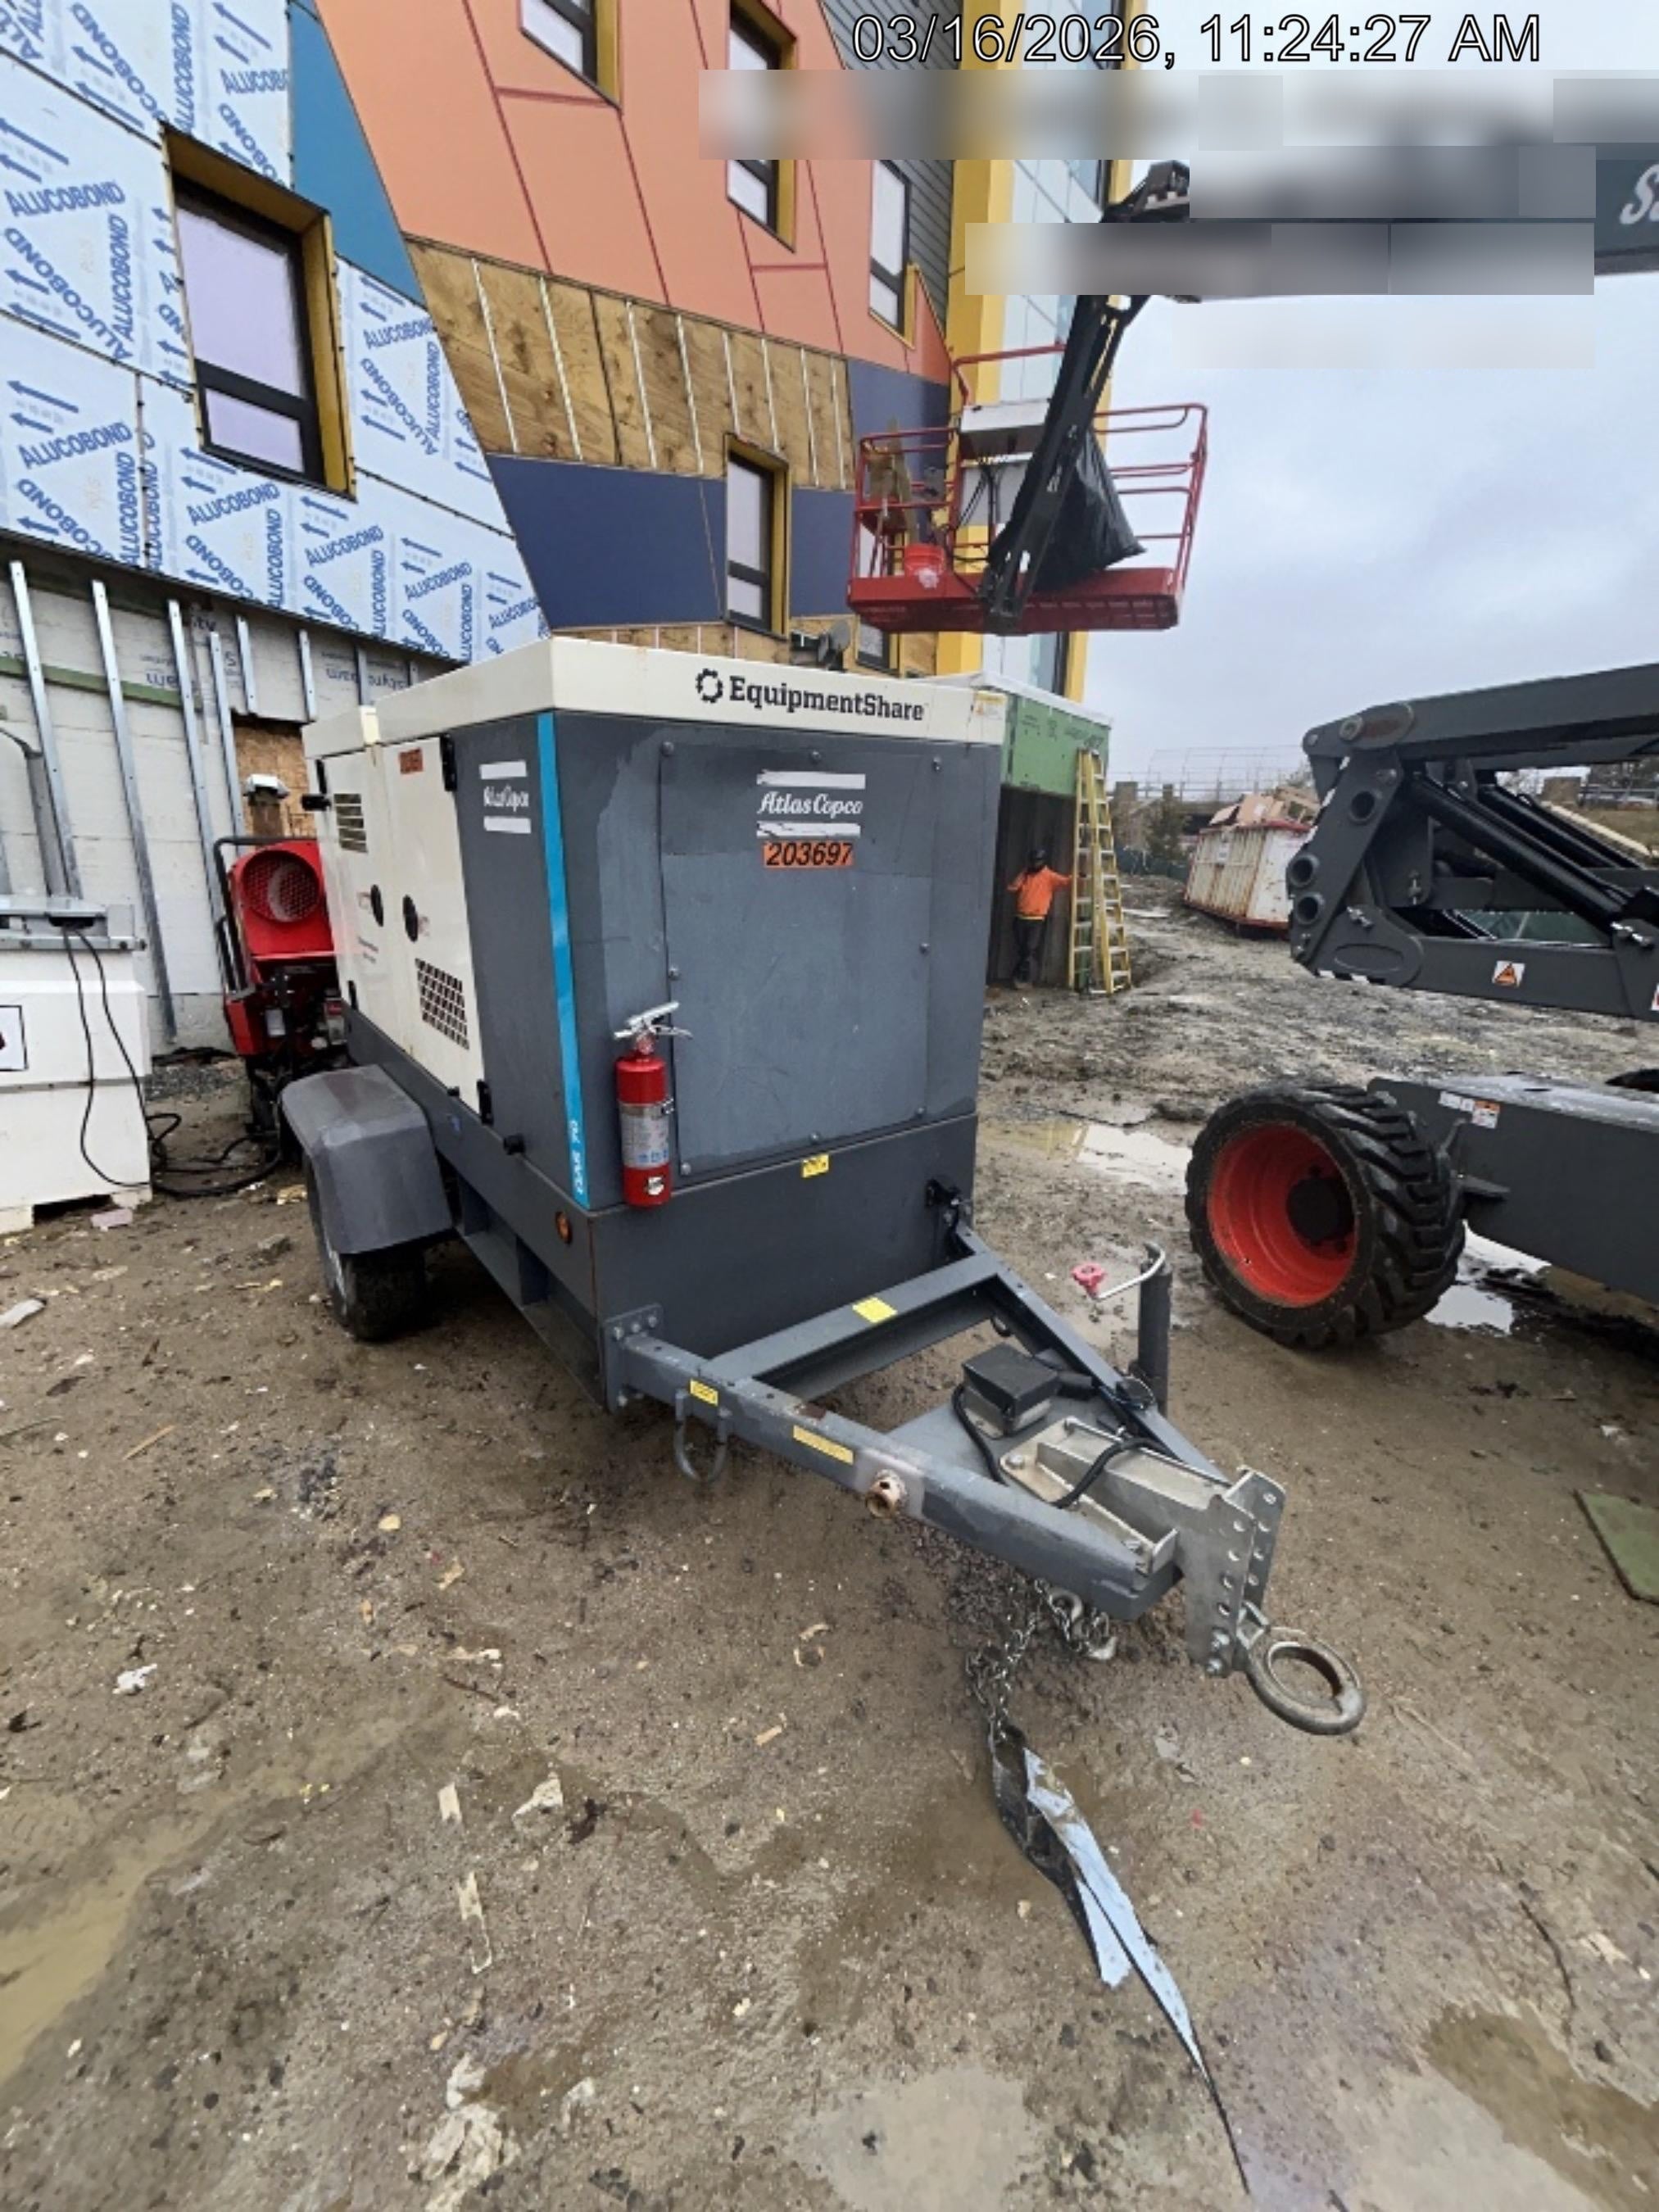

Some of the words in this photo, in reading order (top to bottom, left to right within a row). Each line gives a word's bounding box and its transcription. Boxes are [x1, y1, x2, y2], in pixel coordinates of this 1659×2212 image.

[4, 180, 125, 217] ALUCOBOND
[4, 228, 134, 359] ALUCOBOND
[108, 212, 134, 342] ALUCOBOND
[360, 358, 439, 456] ALUCOBOND
[425, 341, 441, 440] ALUCOBOND
[17, 422, 133, 469] ALUCOBOND
[186, 482, 280, 527] ALUCOBOND
[304, 525, 383, 568] ALUCOBOND
[404, 563, 472, 602] ALUCOBOND
[728, 675, 925, 722] EquipmentShare
[756, 790, 813, 815] Atlas
[811, 791, 863, 818] Copco
[765, 841, 854, 868] 203697
